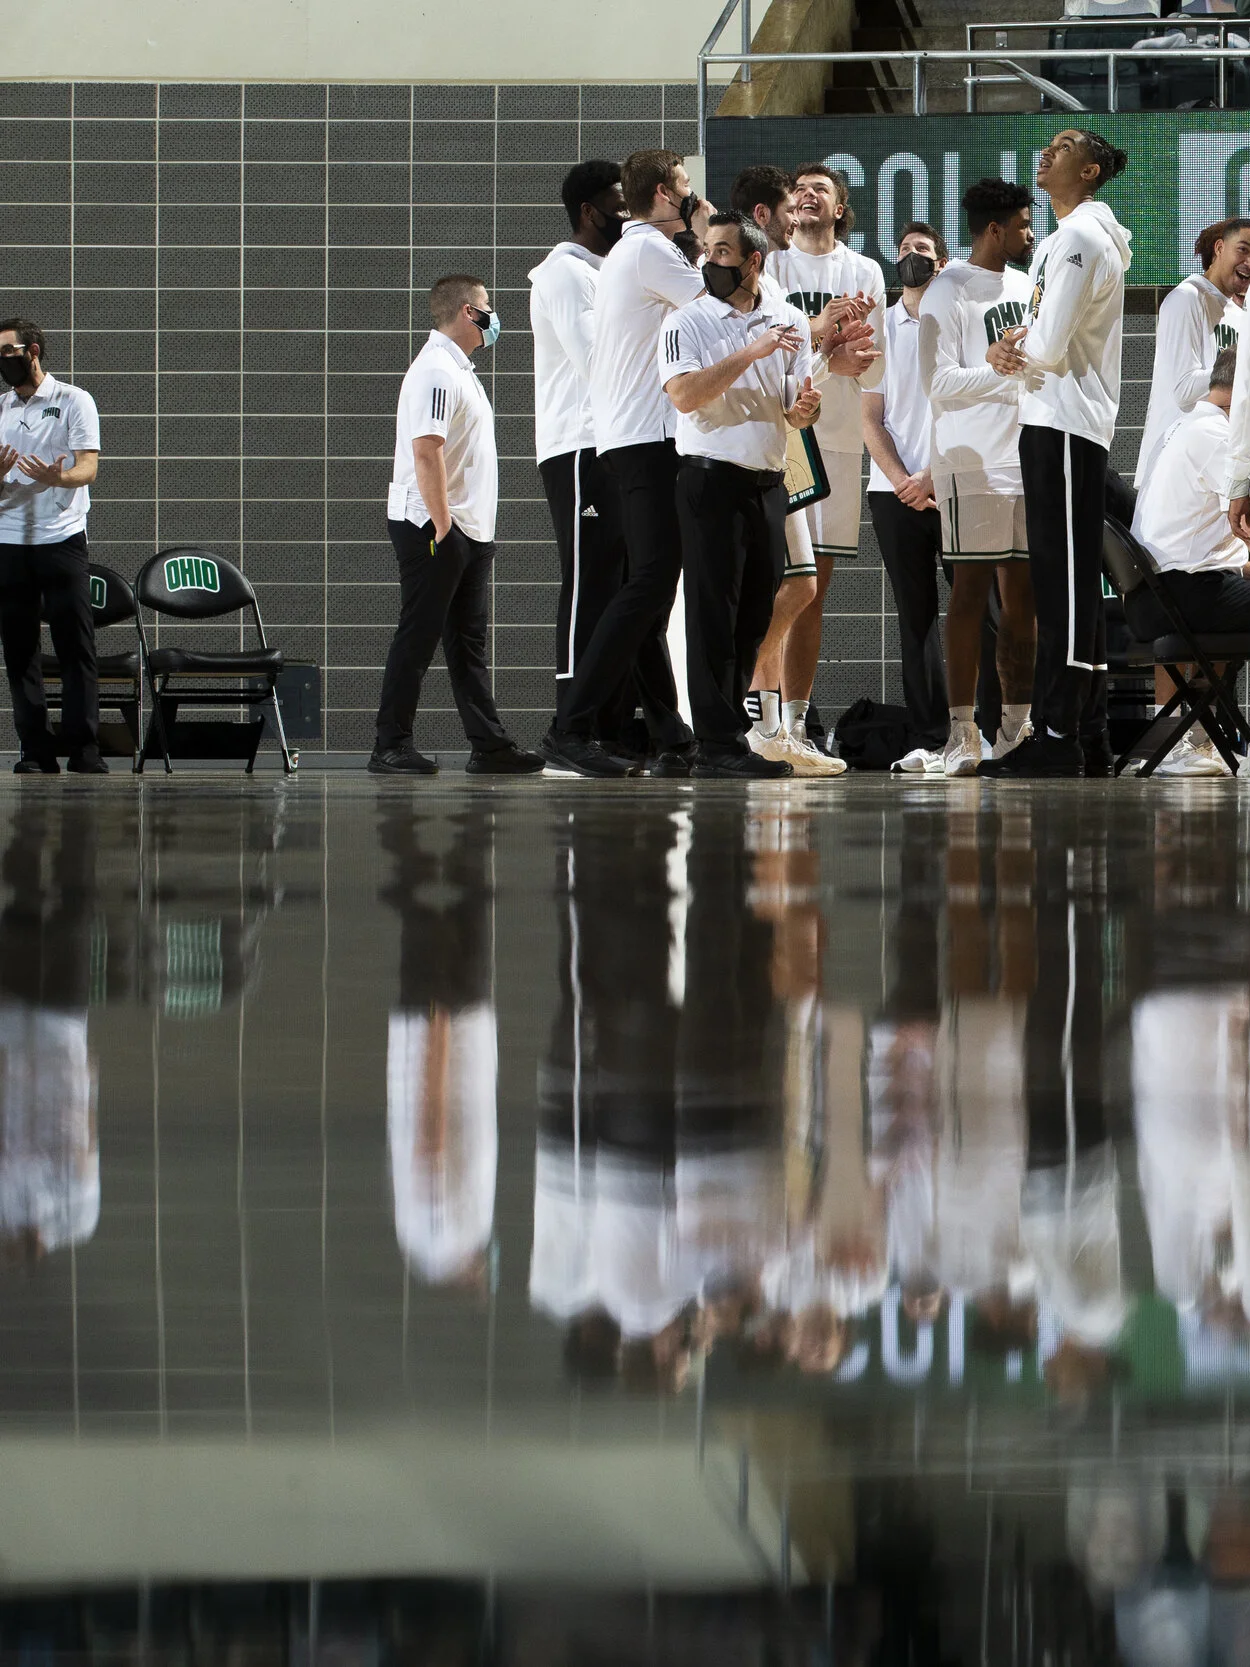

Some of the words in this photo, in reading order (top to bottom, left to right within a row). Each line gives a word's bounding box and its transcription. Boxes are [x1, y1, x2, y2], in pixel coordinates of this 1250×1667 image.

[984, 301, 1028, 346] OHI
[42, 406, 61, 420] OHIO
[164, 556, 220, 592] OHIO
